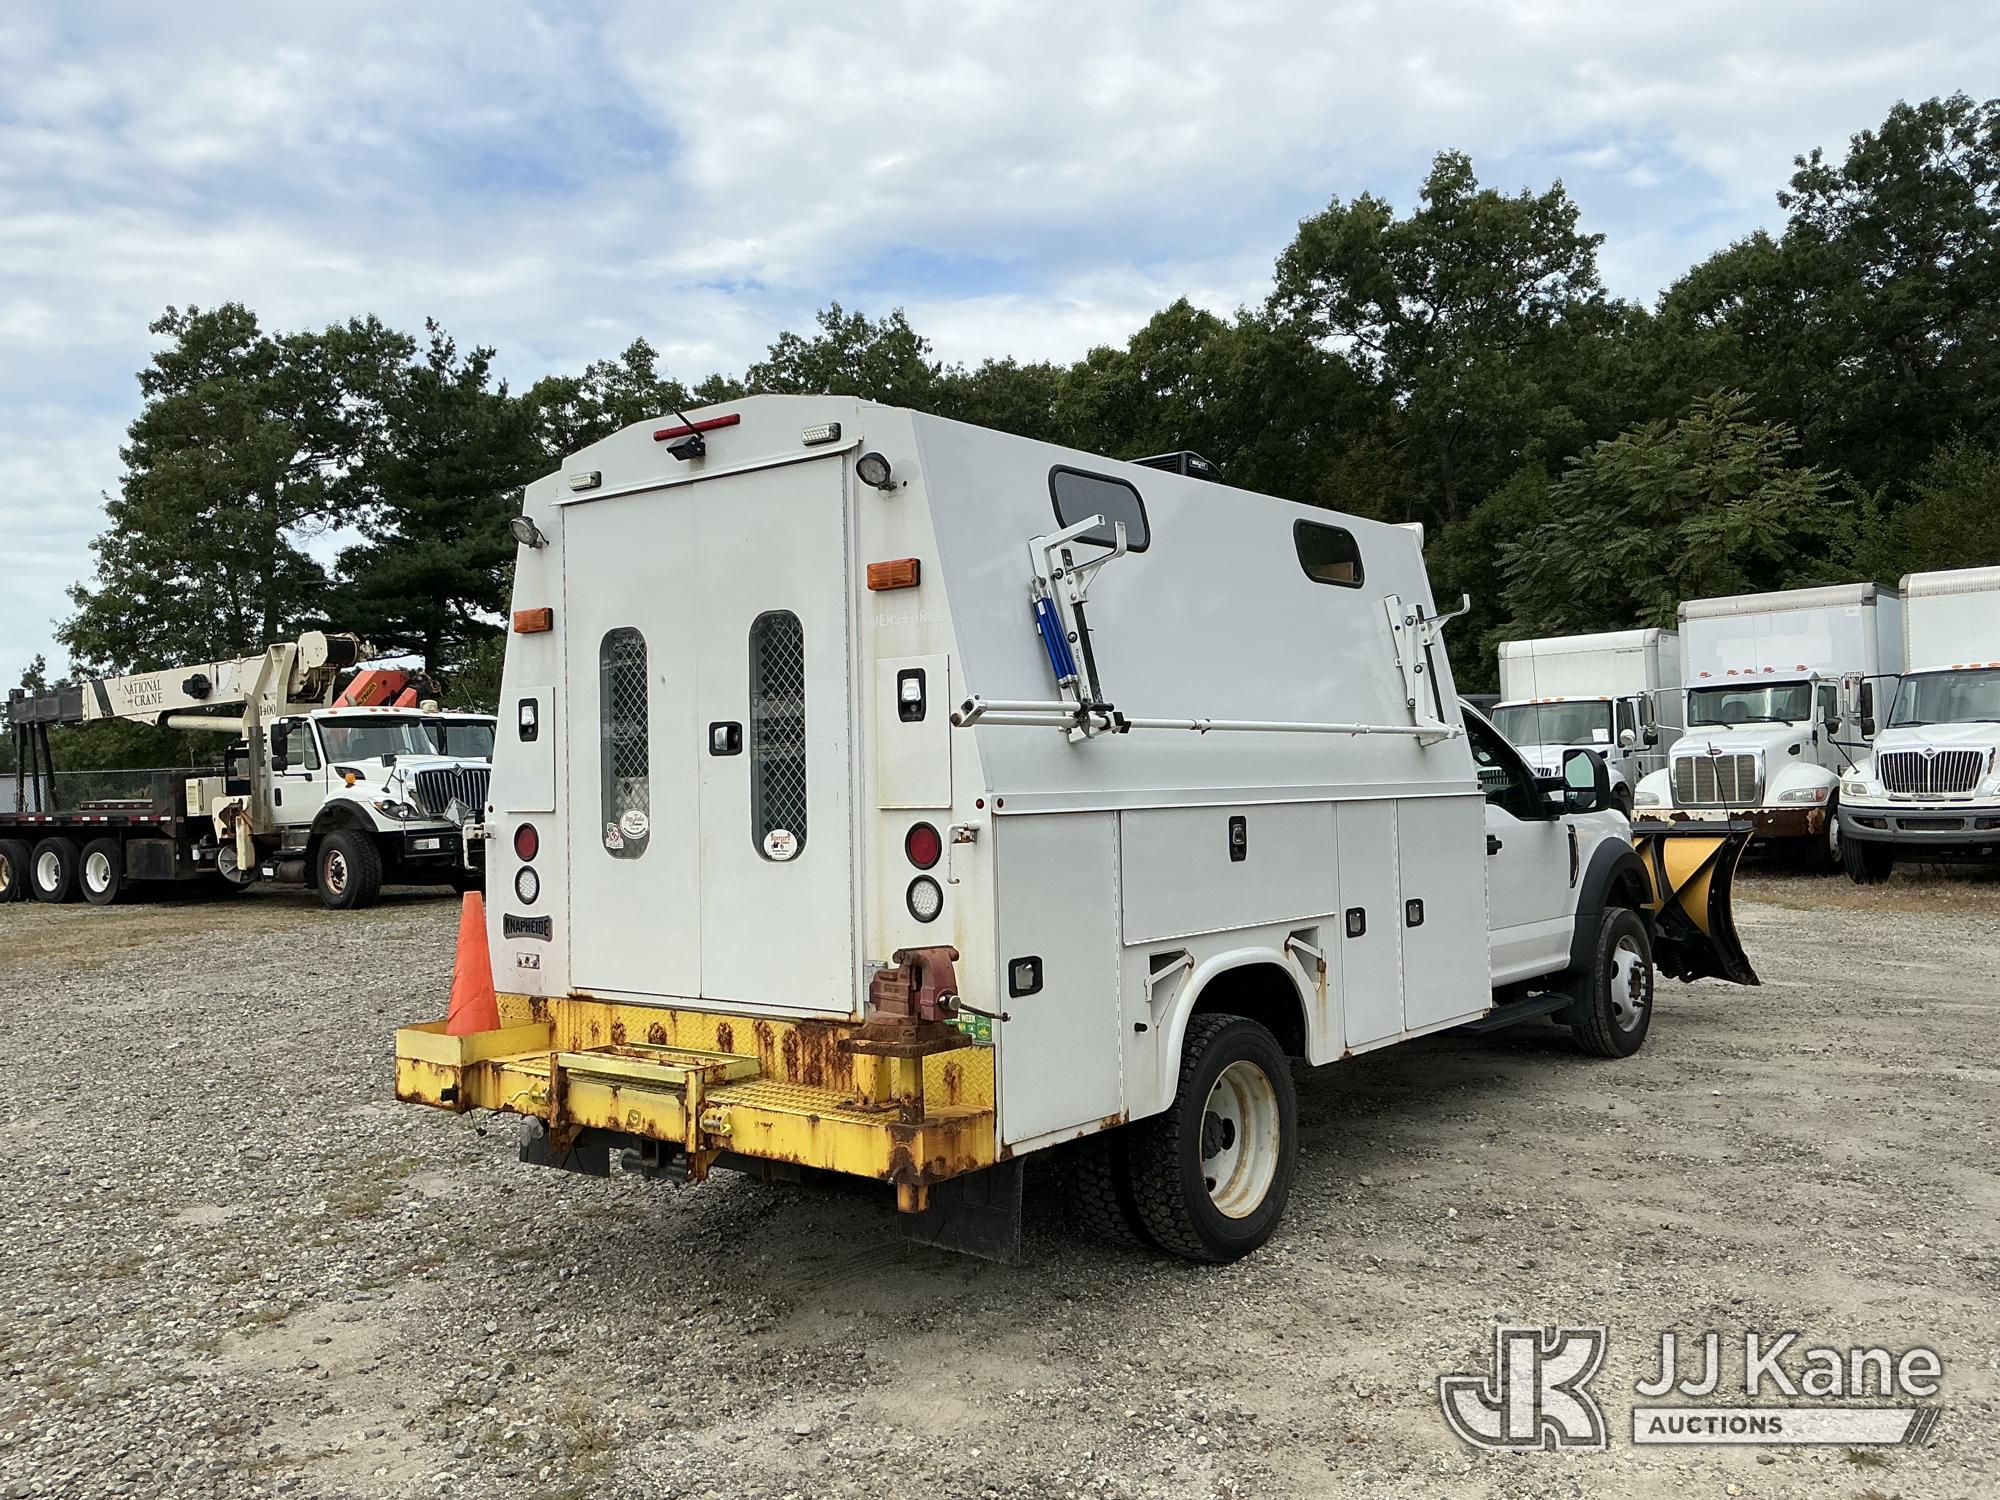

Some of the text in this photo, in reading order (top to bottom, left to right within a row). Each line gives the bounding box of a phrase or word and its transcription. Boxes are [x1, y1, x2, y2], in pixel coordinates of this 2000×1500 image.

[124, 679, 162, 695] NATIONAL
[134, 692, 163, 706] CRANE
[505, 917, 549, 937] KNAPHEIDE
